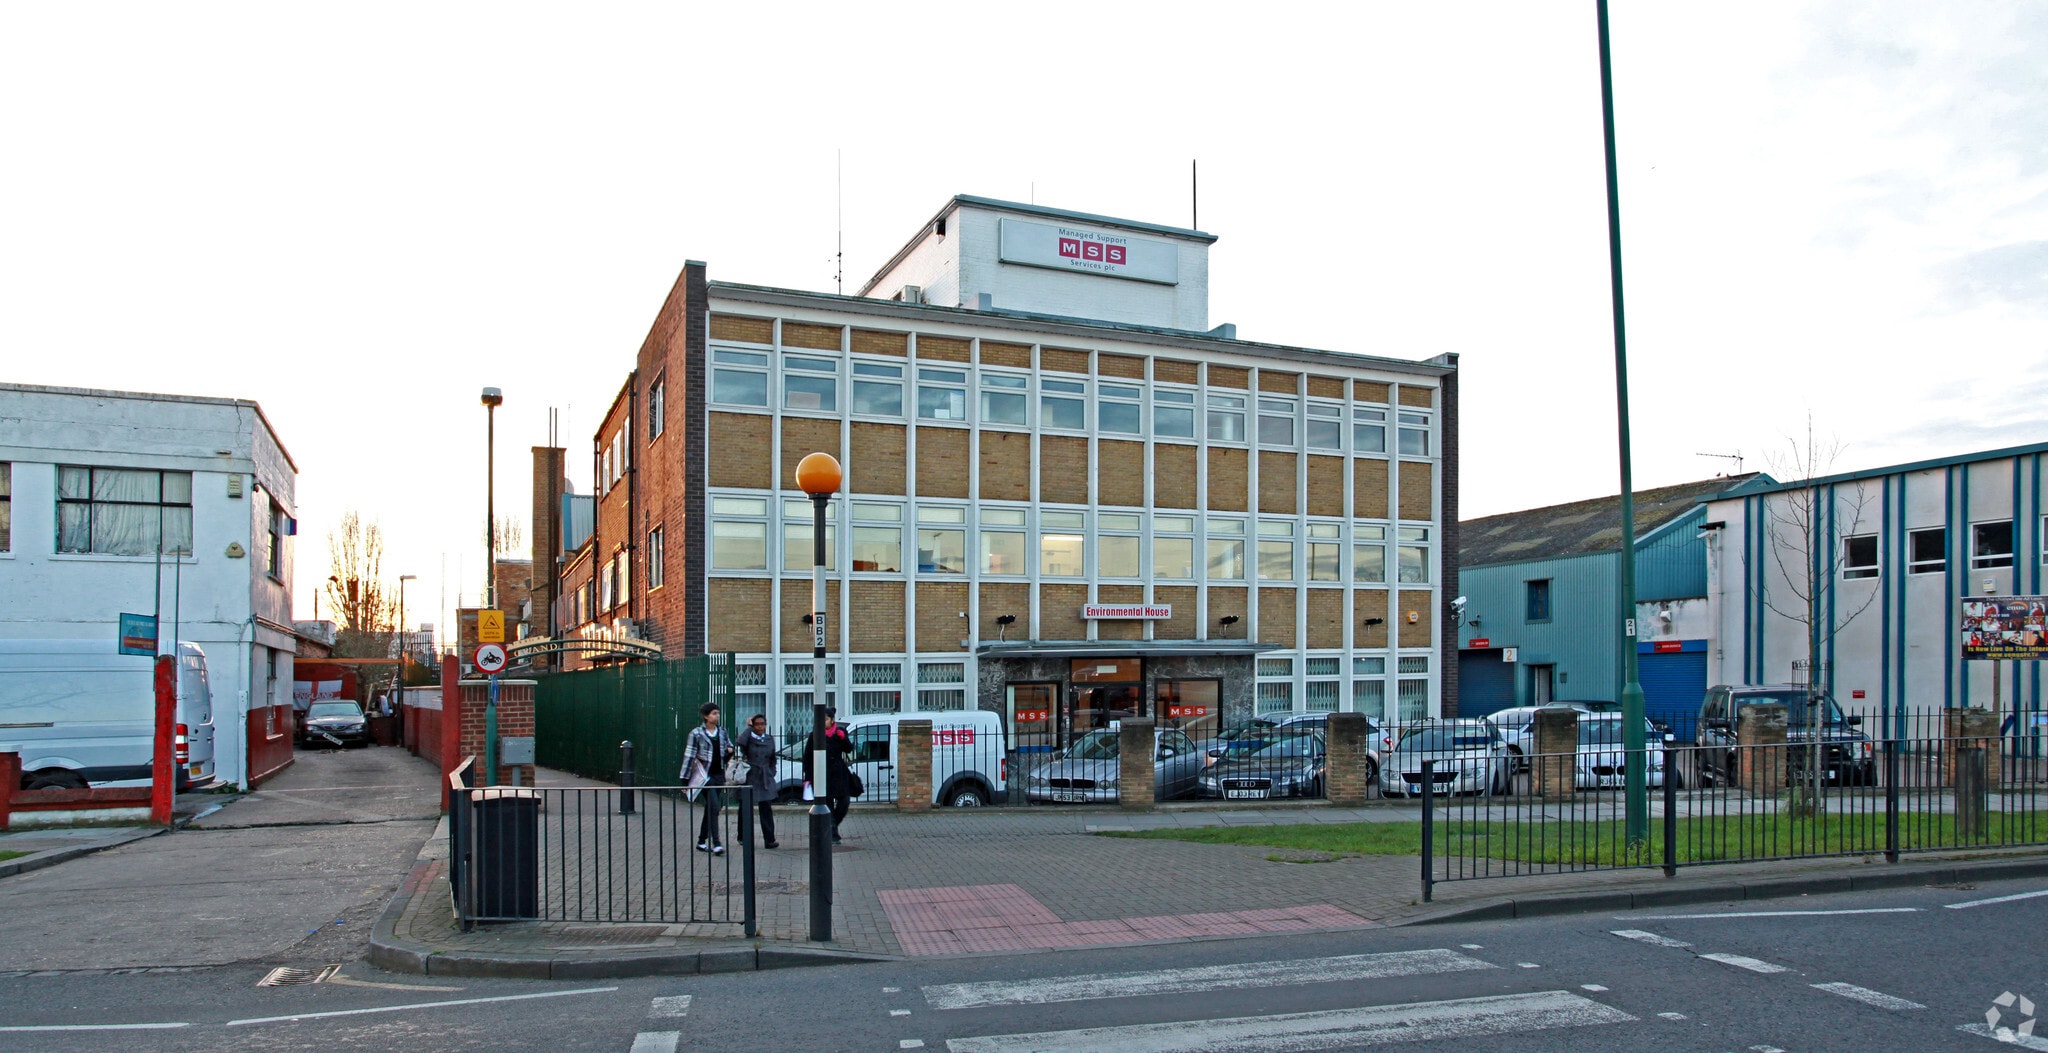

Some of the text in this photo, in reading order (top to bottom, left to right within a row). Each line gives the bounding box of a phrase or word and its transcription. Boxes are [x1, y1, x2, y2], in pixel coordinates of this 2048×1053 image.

[1058, 228, 1127, 244] Managed Support
[1062, 241, 1122, 261] MSS
[1070, 259, 1115, 272] Services plc
[1086, 606, 1169, 616] Environmental House
[816, 616, 824, 646] BB2
[1627, 620, 1633, 635] 21
[1506, 649, 1513, 661] 2
[294, 691, 334, 700] ENGLAND
[1017, 711, 1046, 721] MSS
[1171, 707, 1204, 715] MSS
